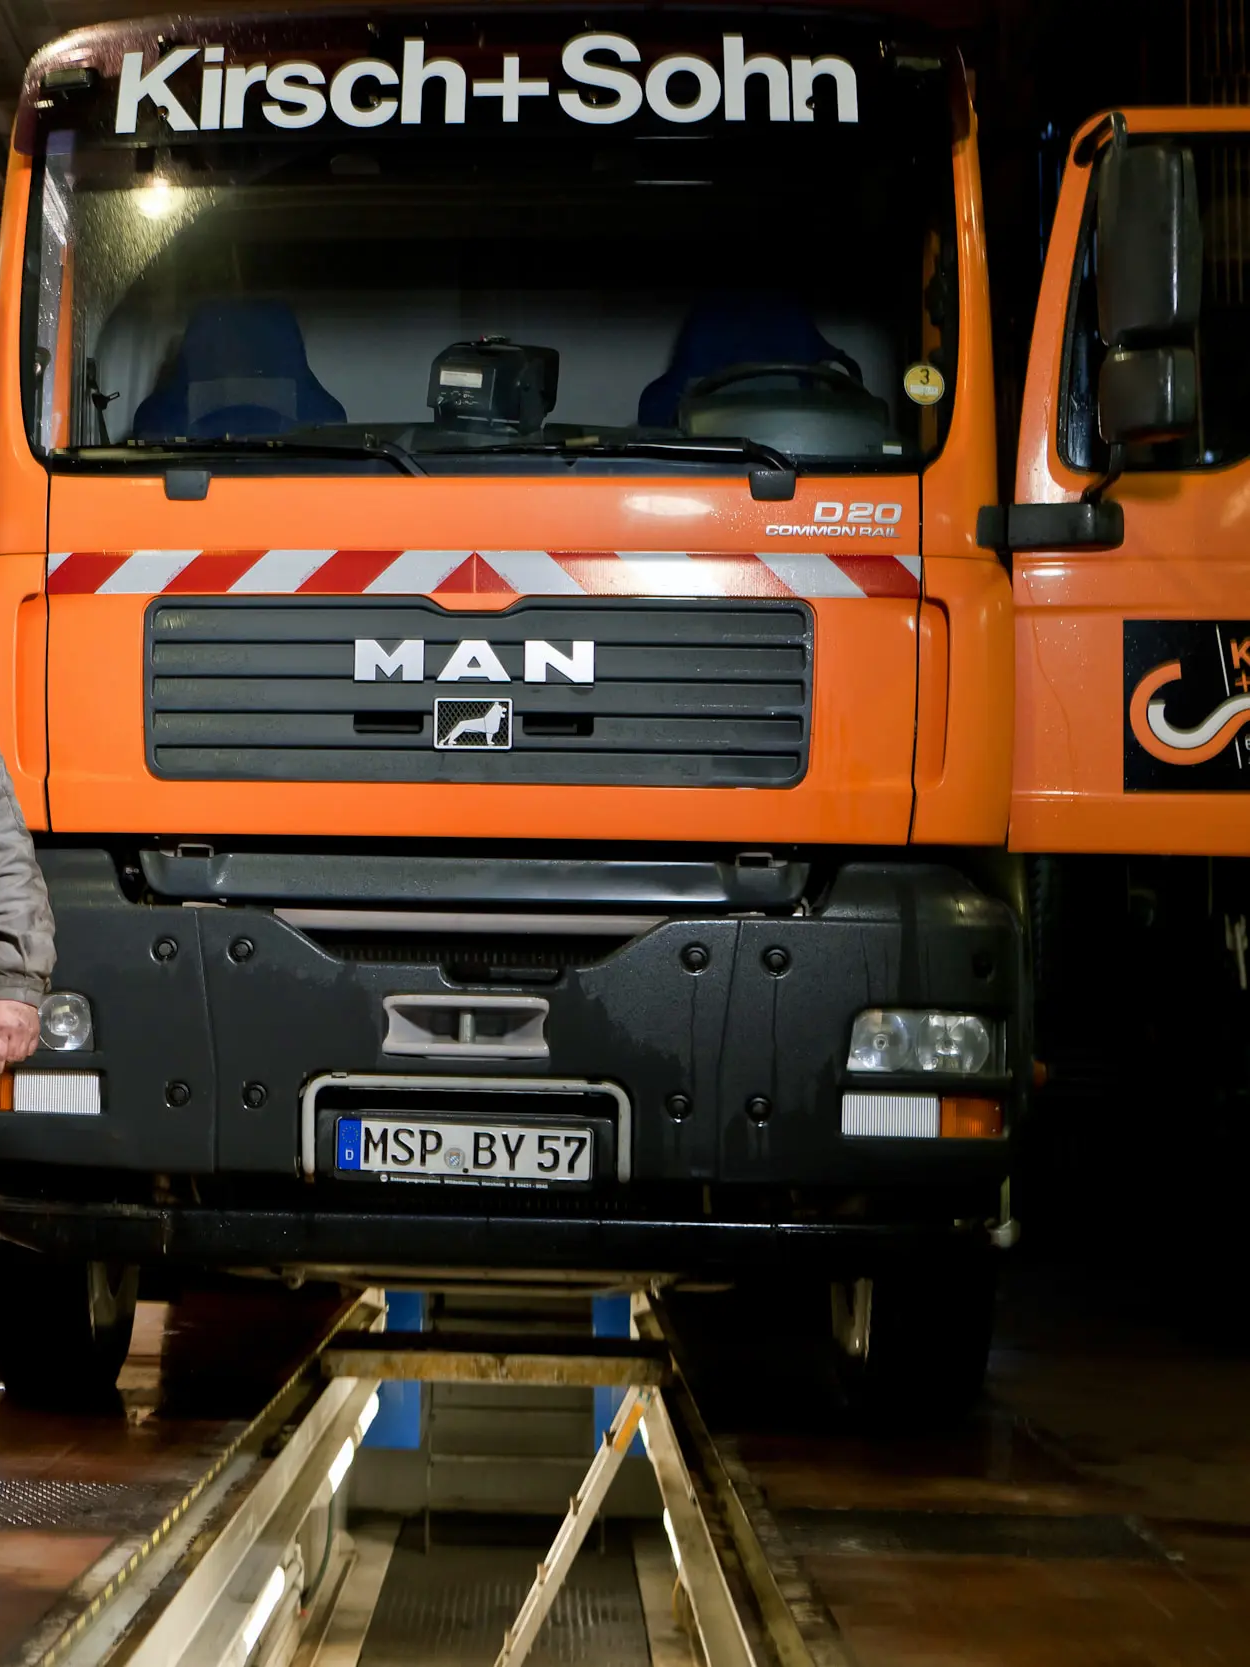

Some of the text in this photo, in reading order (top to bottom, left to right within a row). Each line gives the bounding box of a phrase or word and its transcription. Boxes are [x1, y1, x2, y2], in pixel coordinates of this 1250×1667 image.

[114, 33, 860, 134] Kirsch+Sohn
[919, 368, 930, 385] 3
[765, 525, 902, 538] COMMON RAIL
[353, 639, 595, 685] MAN
[345, 1149, 354, 1161] D
[363, 1127, 588, 1174] MSP BY 57
